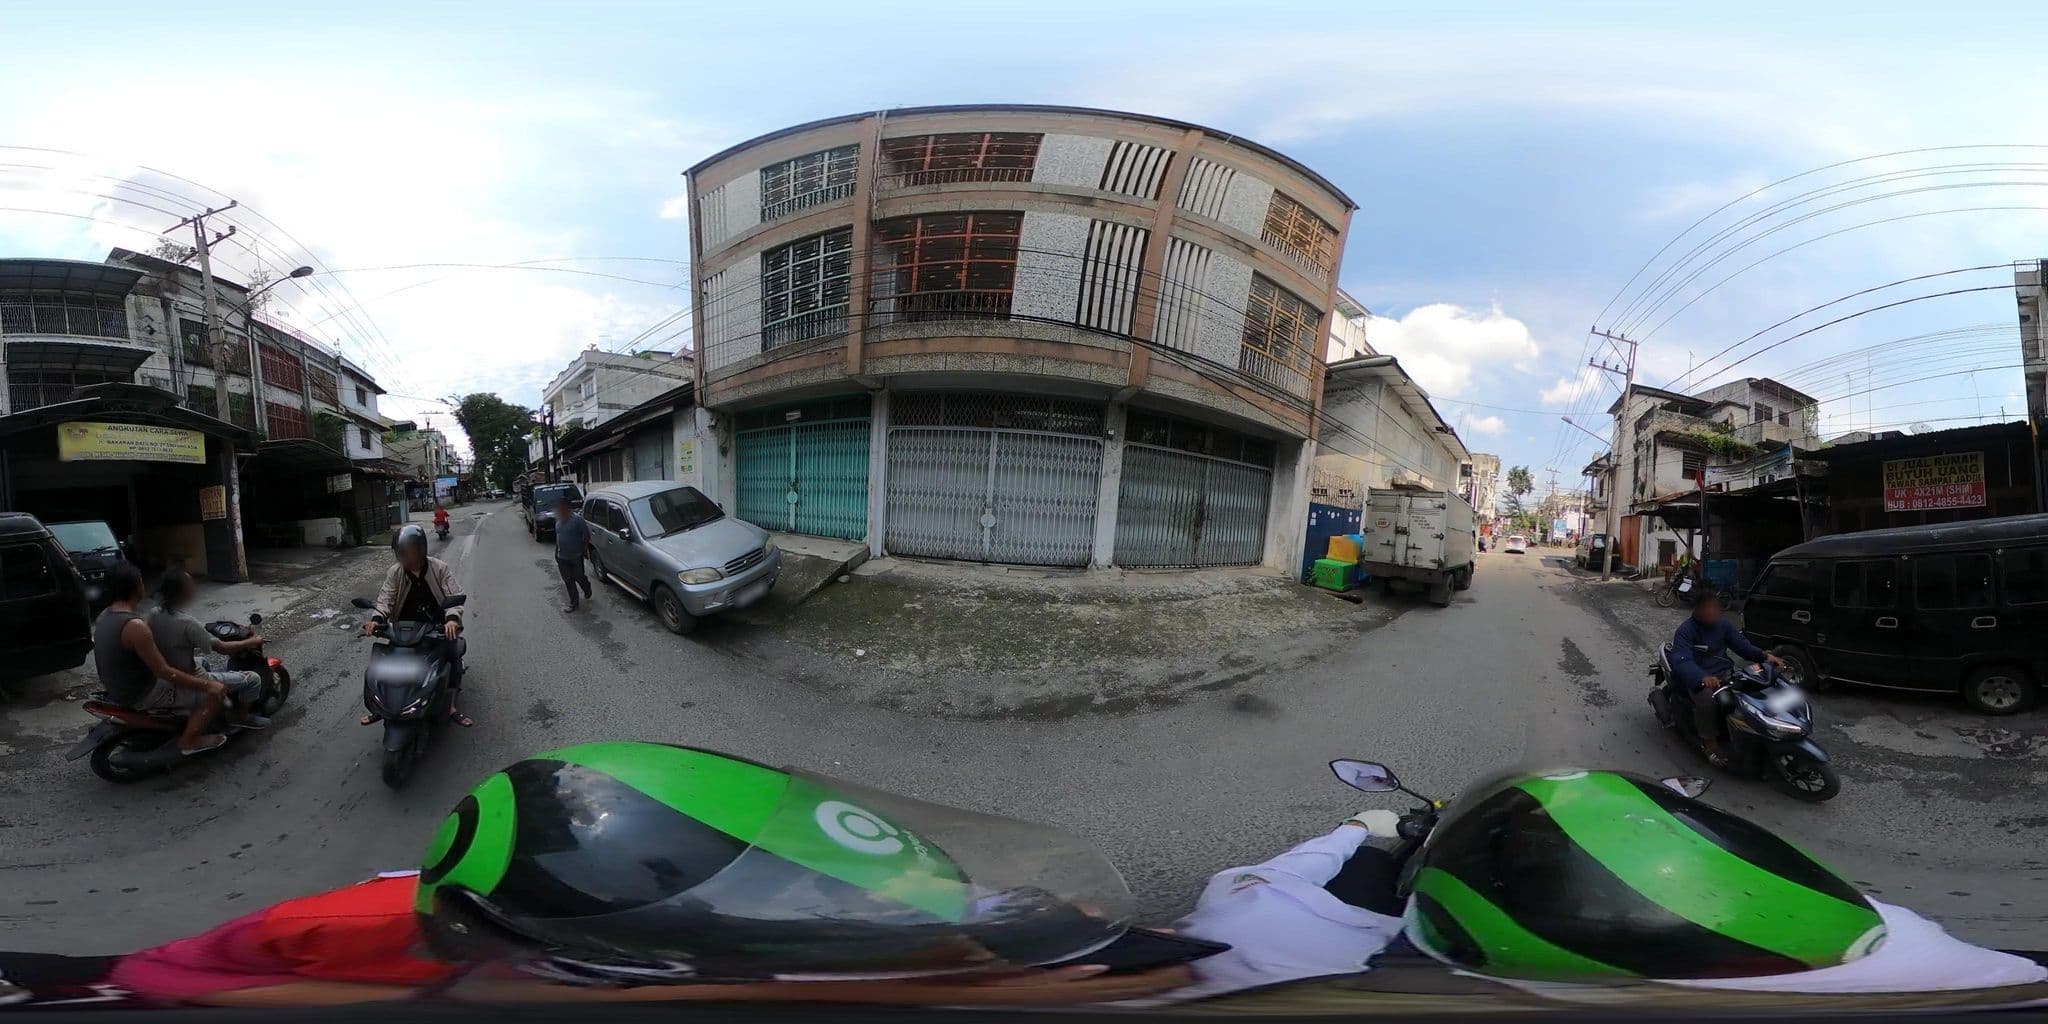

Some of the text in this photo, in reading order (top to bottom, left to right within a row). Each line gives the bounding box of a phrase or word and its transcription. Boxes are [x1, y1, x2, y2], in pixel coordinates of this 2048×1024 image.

[107, 425, 148, 433] ANGKUTAN
[1888, 465, 1979, 480] BUTUH UANG
[1894, 489, 1907, 498] UK
[1946, 484, 1973, 496] (SHM)
[1887, 500, 1905, 509] HUB
